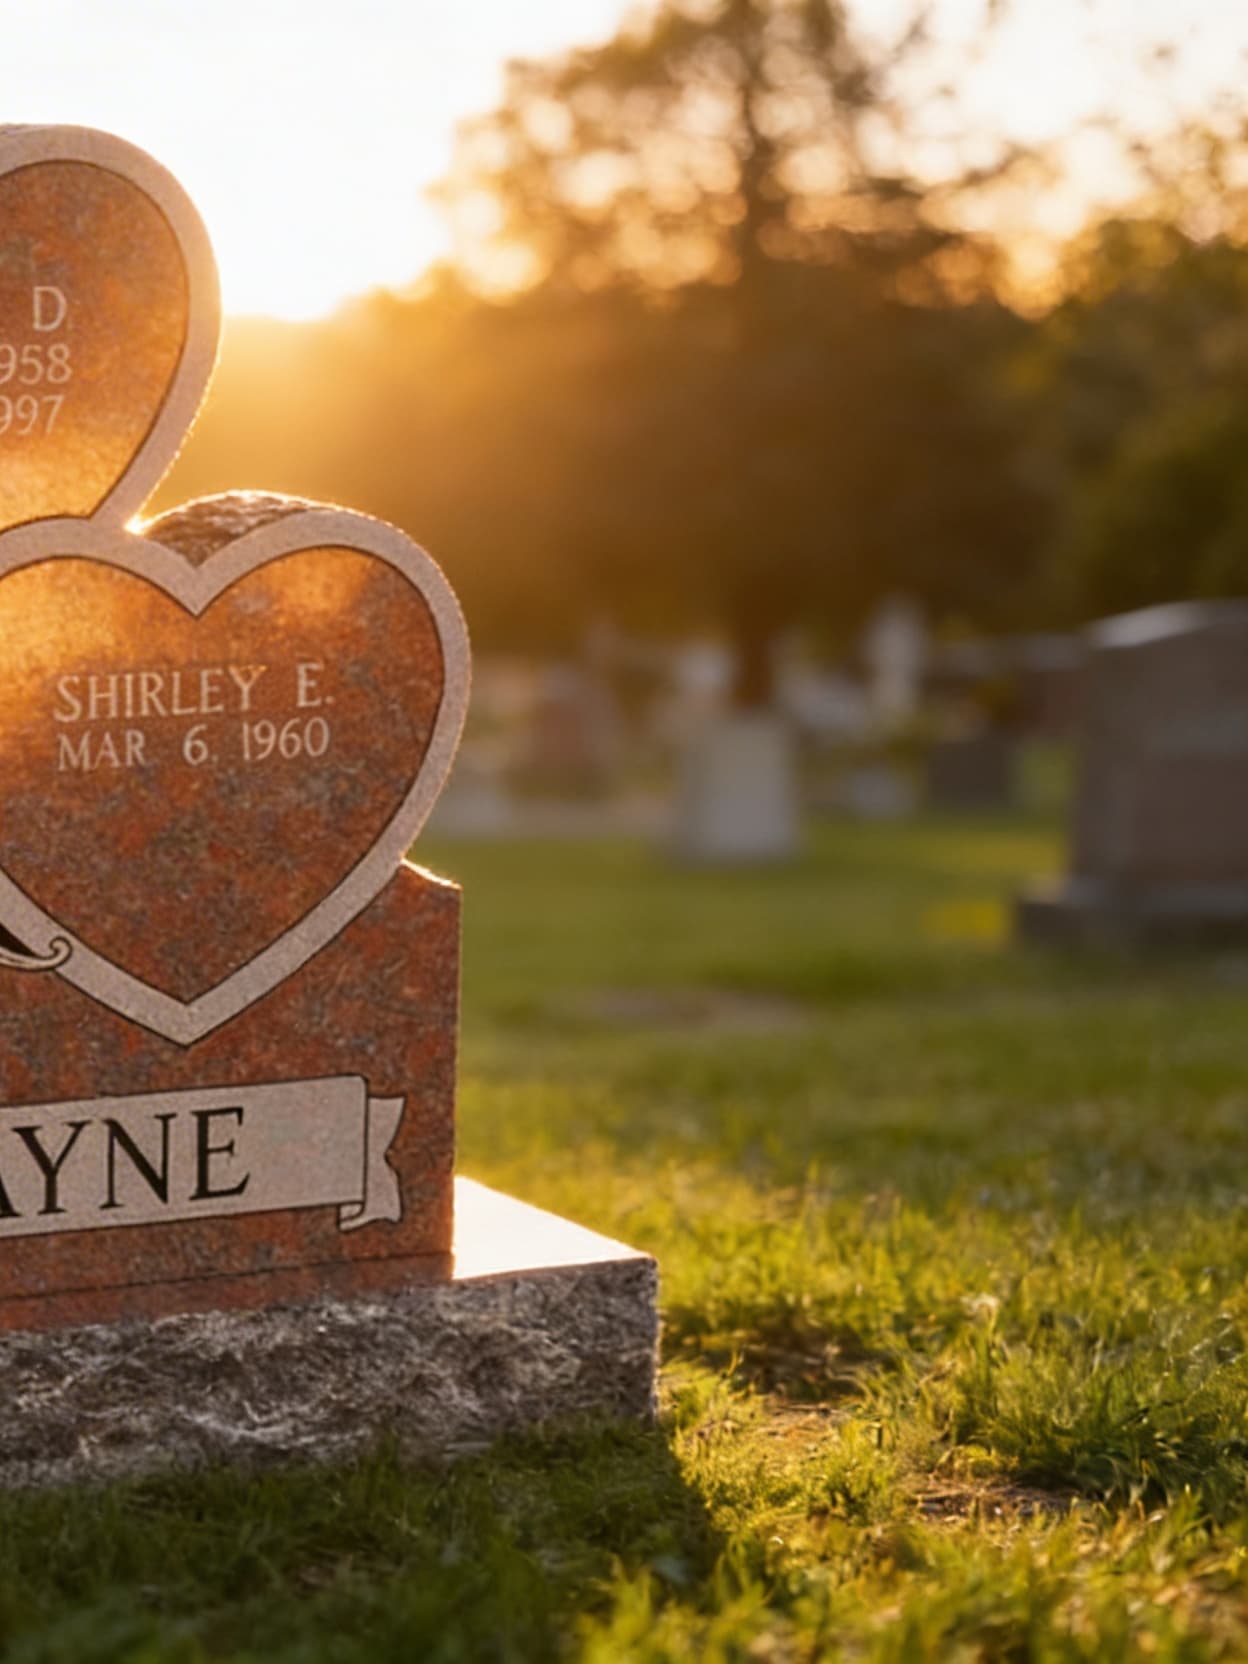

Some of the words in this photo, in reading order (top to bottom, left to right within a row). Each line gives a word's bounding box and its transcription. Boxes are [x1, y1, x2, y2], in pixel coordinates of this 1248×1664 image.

[54, 664, 268, 723] SHIRLEY
[295, 662, 336, 708] E.
[242, 716, 330, 761] 1960
